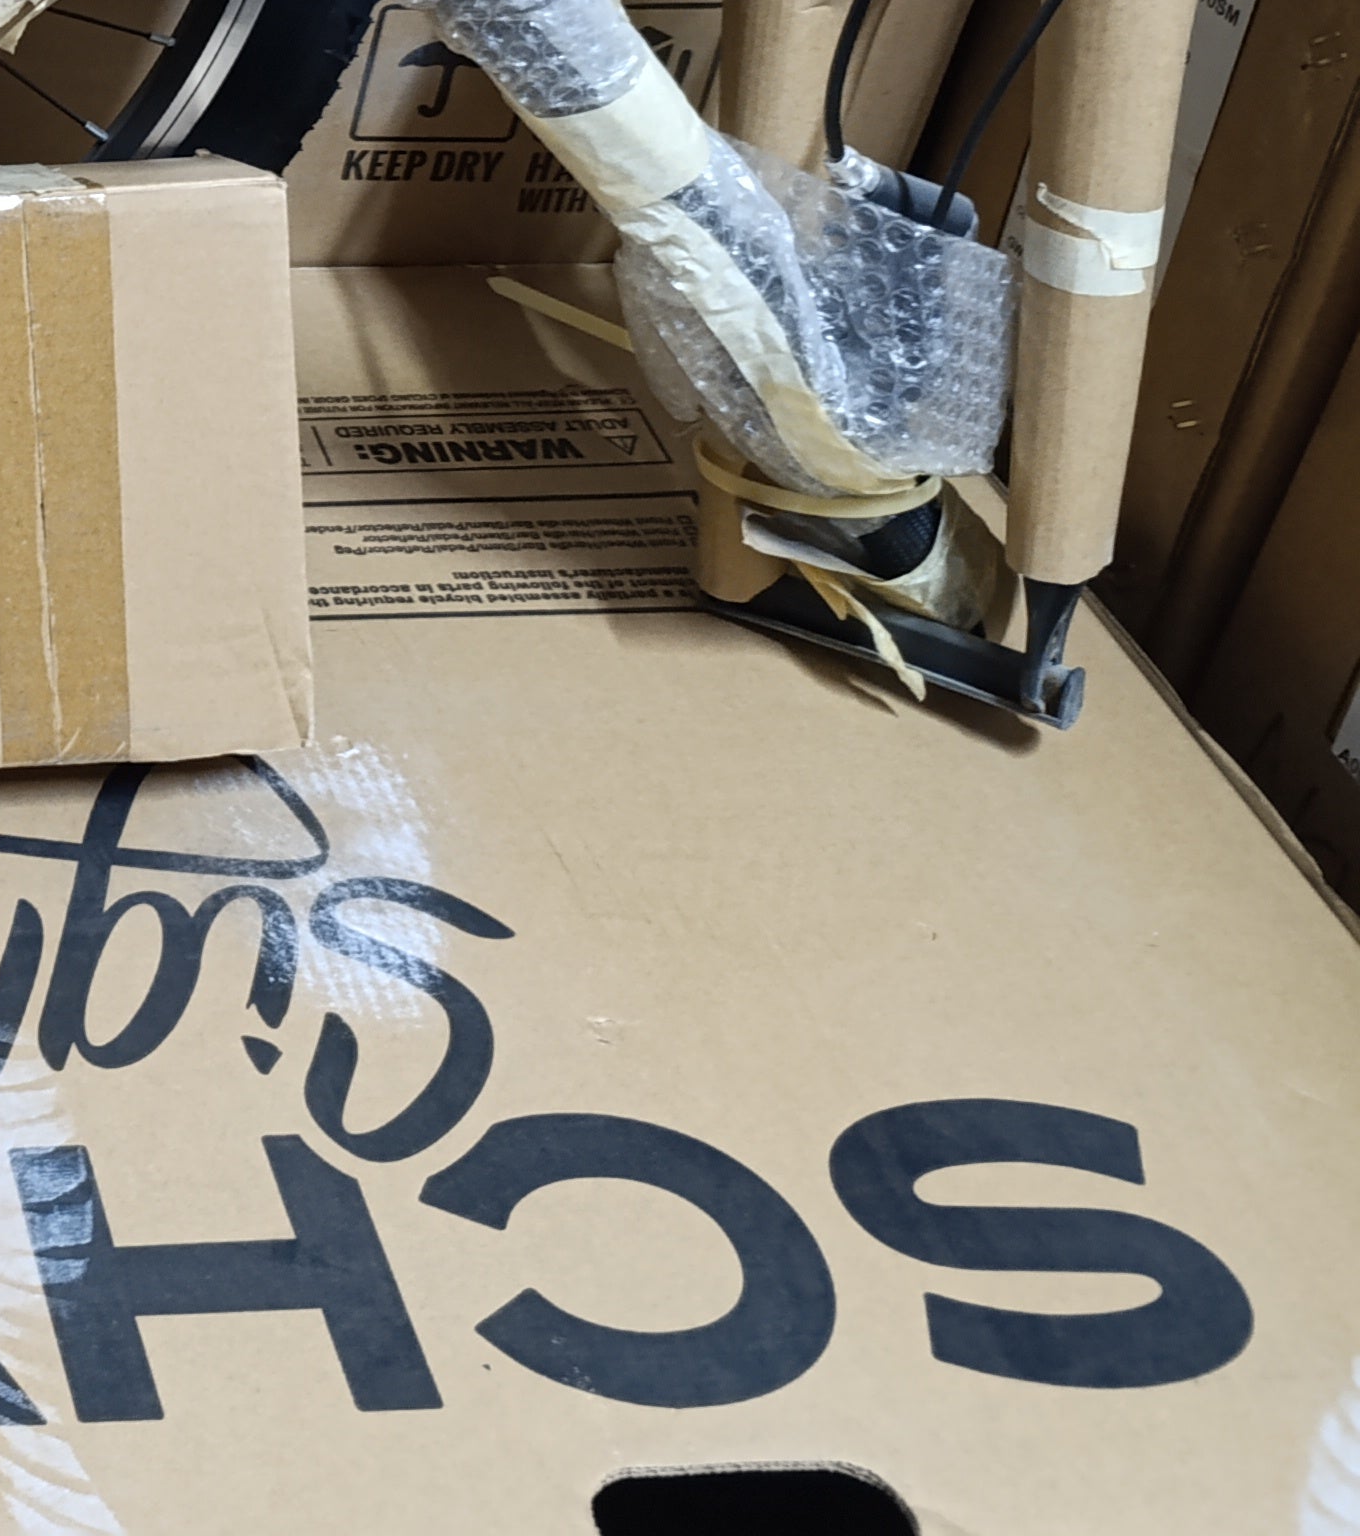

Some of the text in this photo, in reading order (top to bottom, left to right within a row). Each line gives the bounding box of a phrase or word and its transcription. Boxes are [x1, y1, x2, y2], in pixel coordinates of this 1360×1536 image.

[341, 150, 432, 182] KEEP
[428, 151, 506, 182] DRY
[334, 417, 629, 440] ADULT ASSEMBLY REQUIRED
[353, 436, 582, 465] WARNING:
